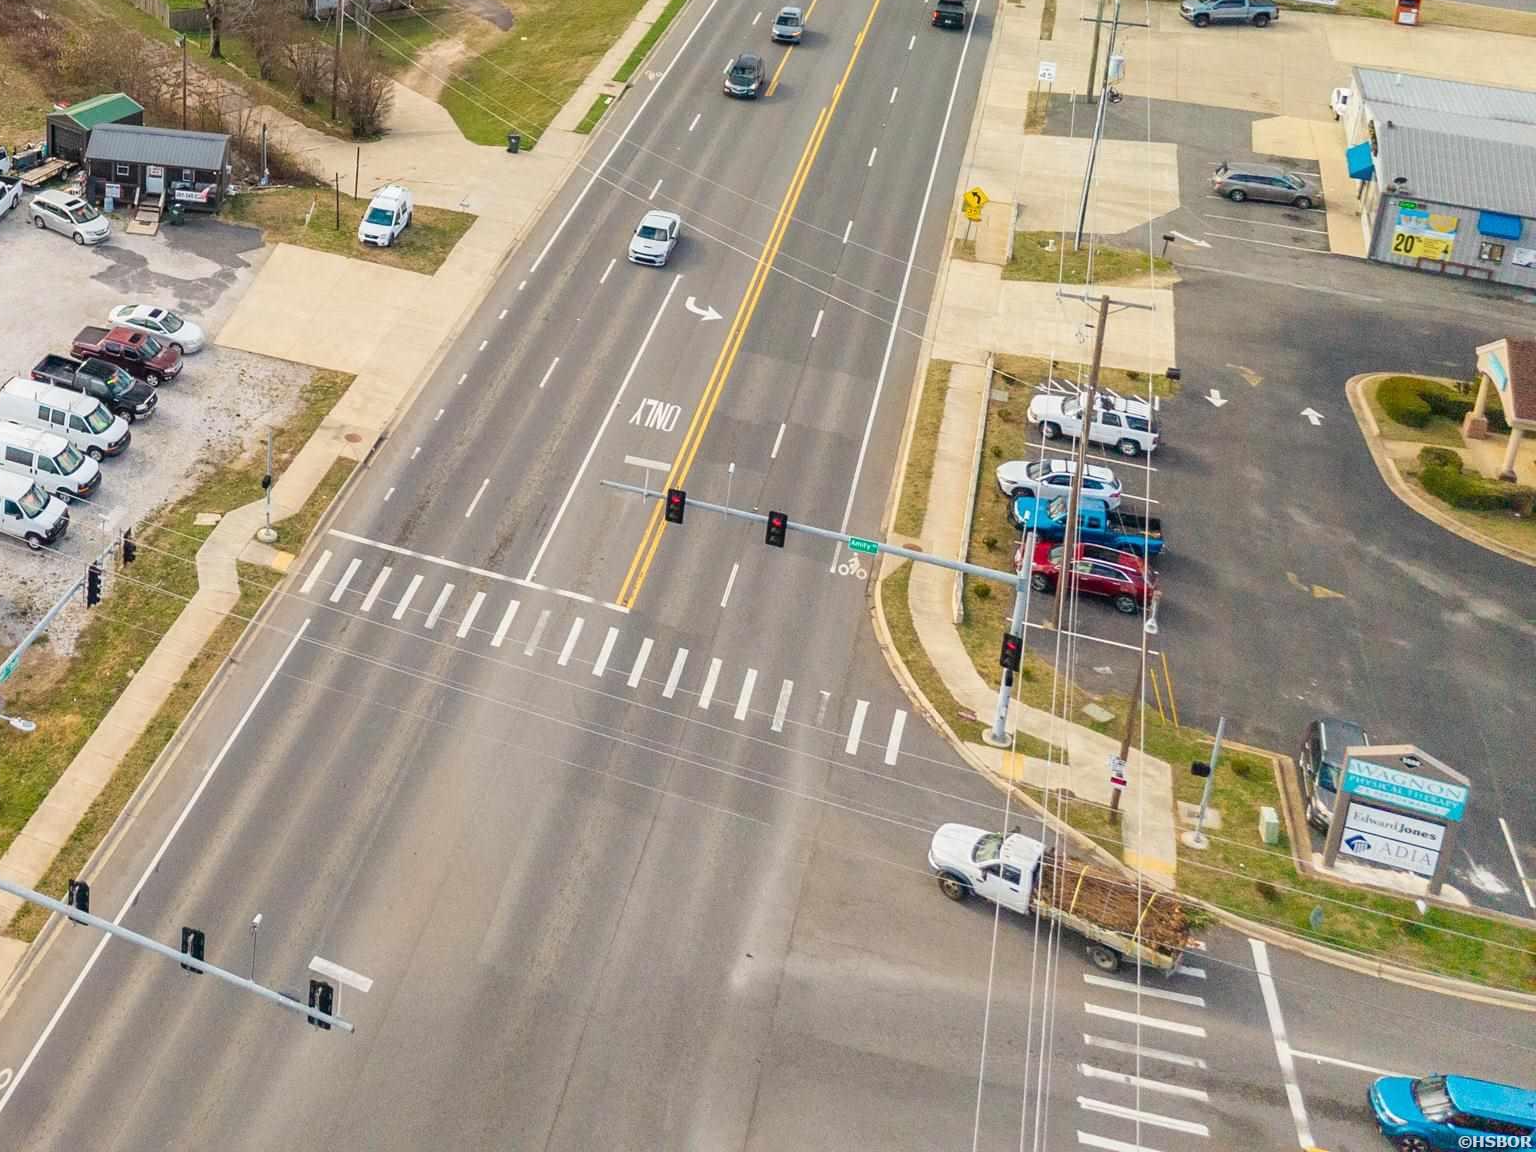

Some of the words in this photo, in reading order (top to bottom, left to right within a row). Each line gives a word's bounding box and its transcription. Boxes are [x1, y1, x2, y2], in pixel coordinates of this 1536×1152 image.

[1393, 233, 1415, 254] 20
[629, 398, 682, 432] ONLY
[1348, 774, 1404, 795] PHYSICAL
[1406, 787, 1460, 809] THERAPY
[1352, 760, 1462, 799] WAGNON
[1378, 842, 1433, 866] ADIA
